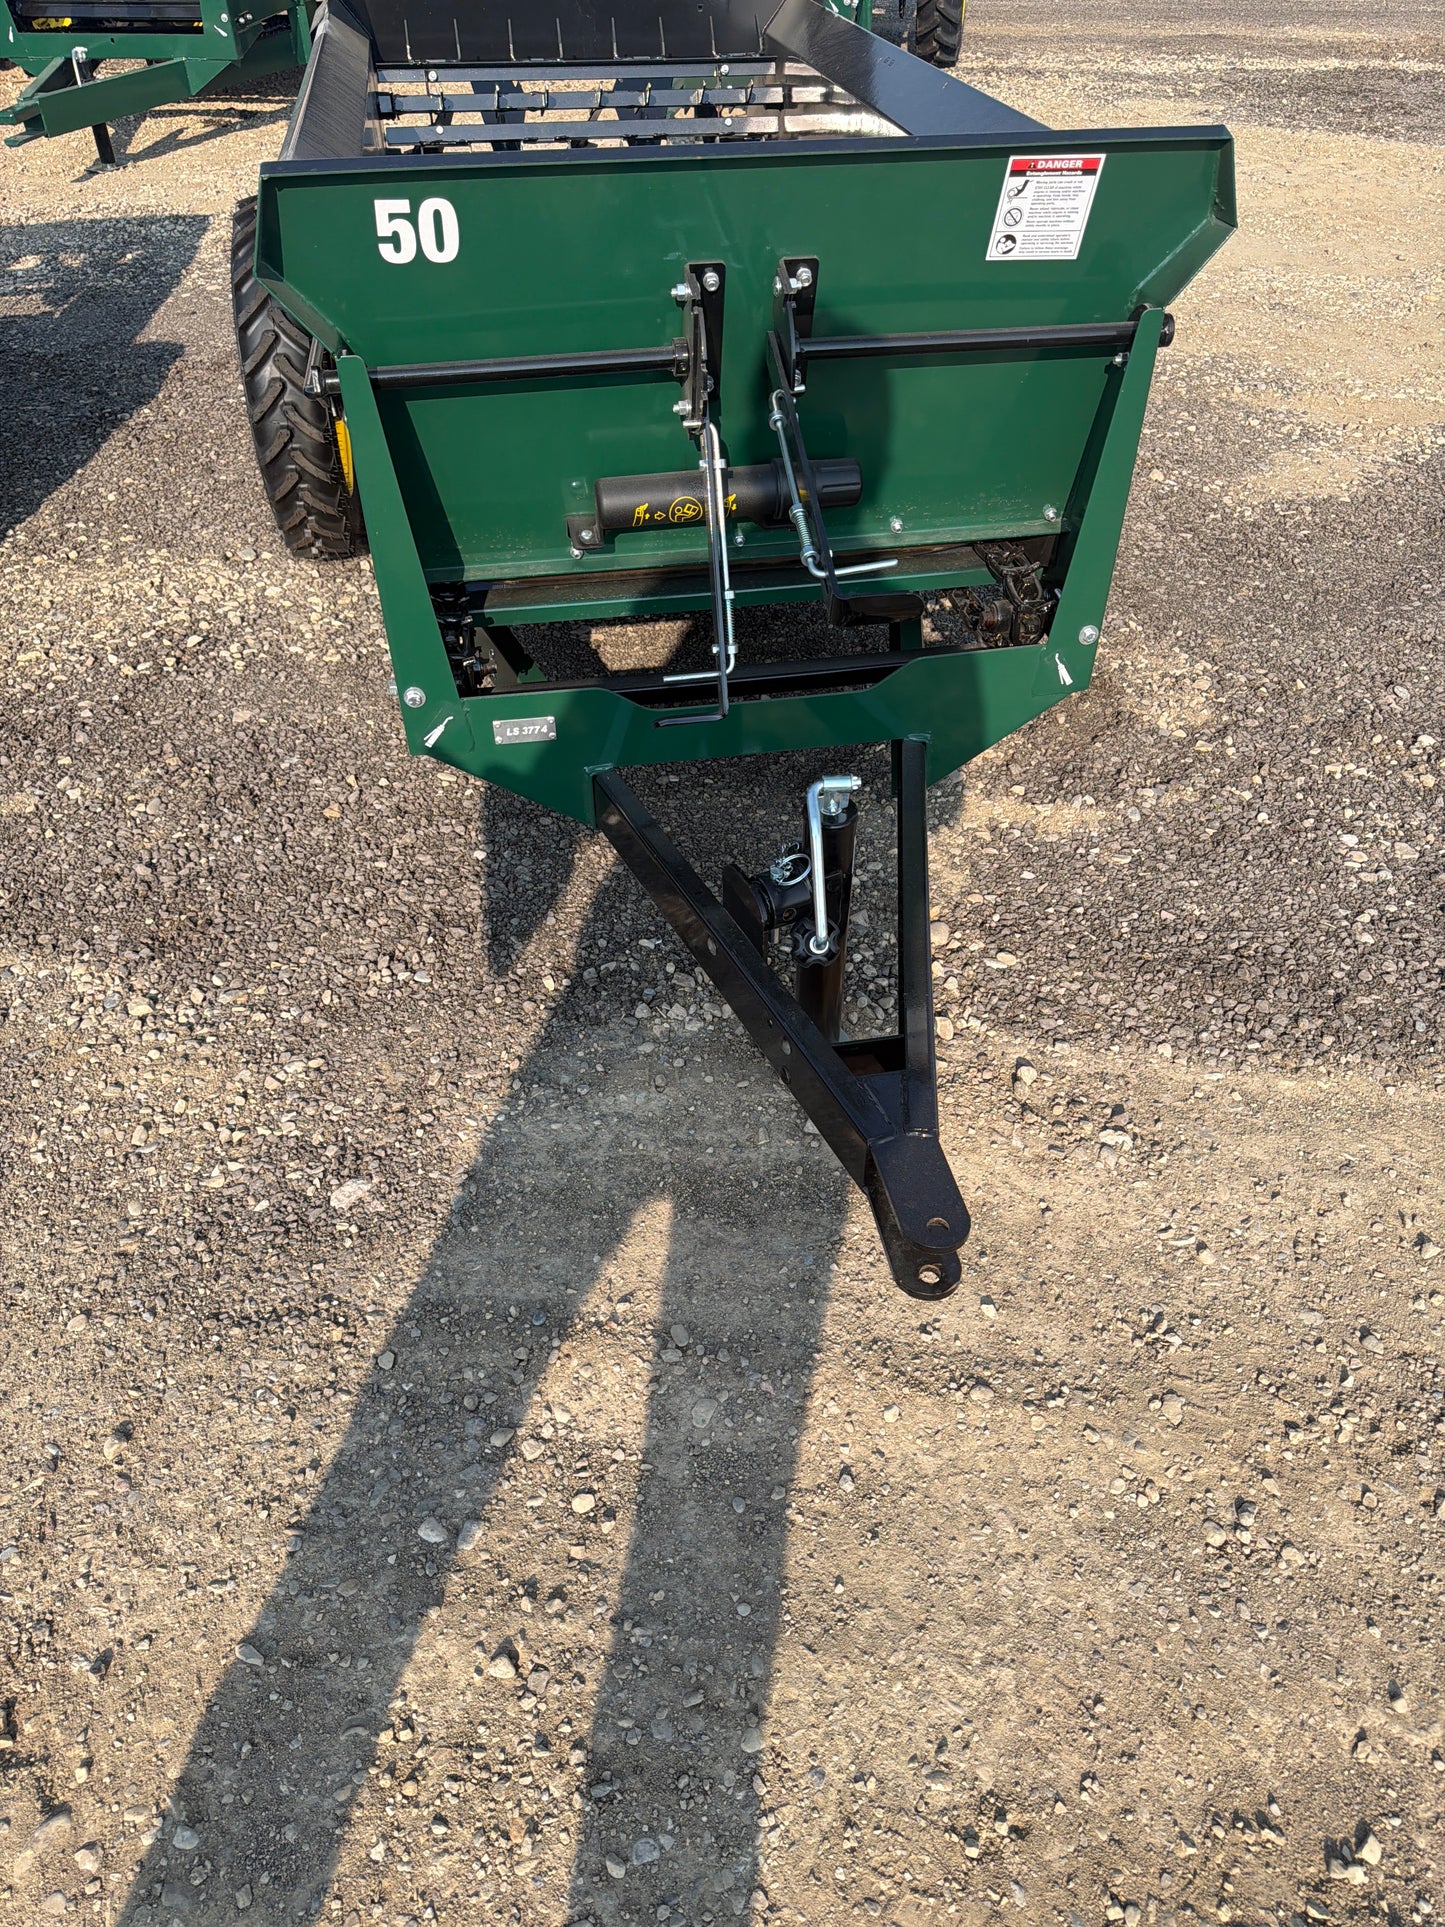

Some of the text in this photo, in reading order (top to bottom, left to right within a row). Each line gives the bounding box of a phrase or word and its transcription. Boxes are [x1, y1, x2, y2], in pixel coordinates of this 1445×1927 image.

[1037, 160, 1083, 168] DANGER
[374, 198, 459, 264] 50
[507, 725, 547, 736] LS 3774
